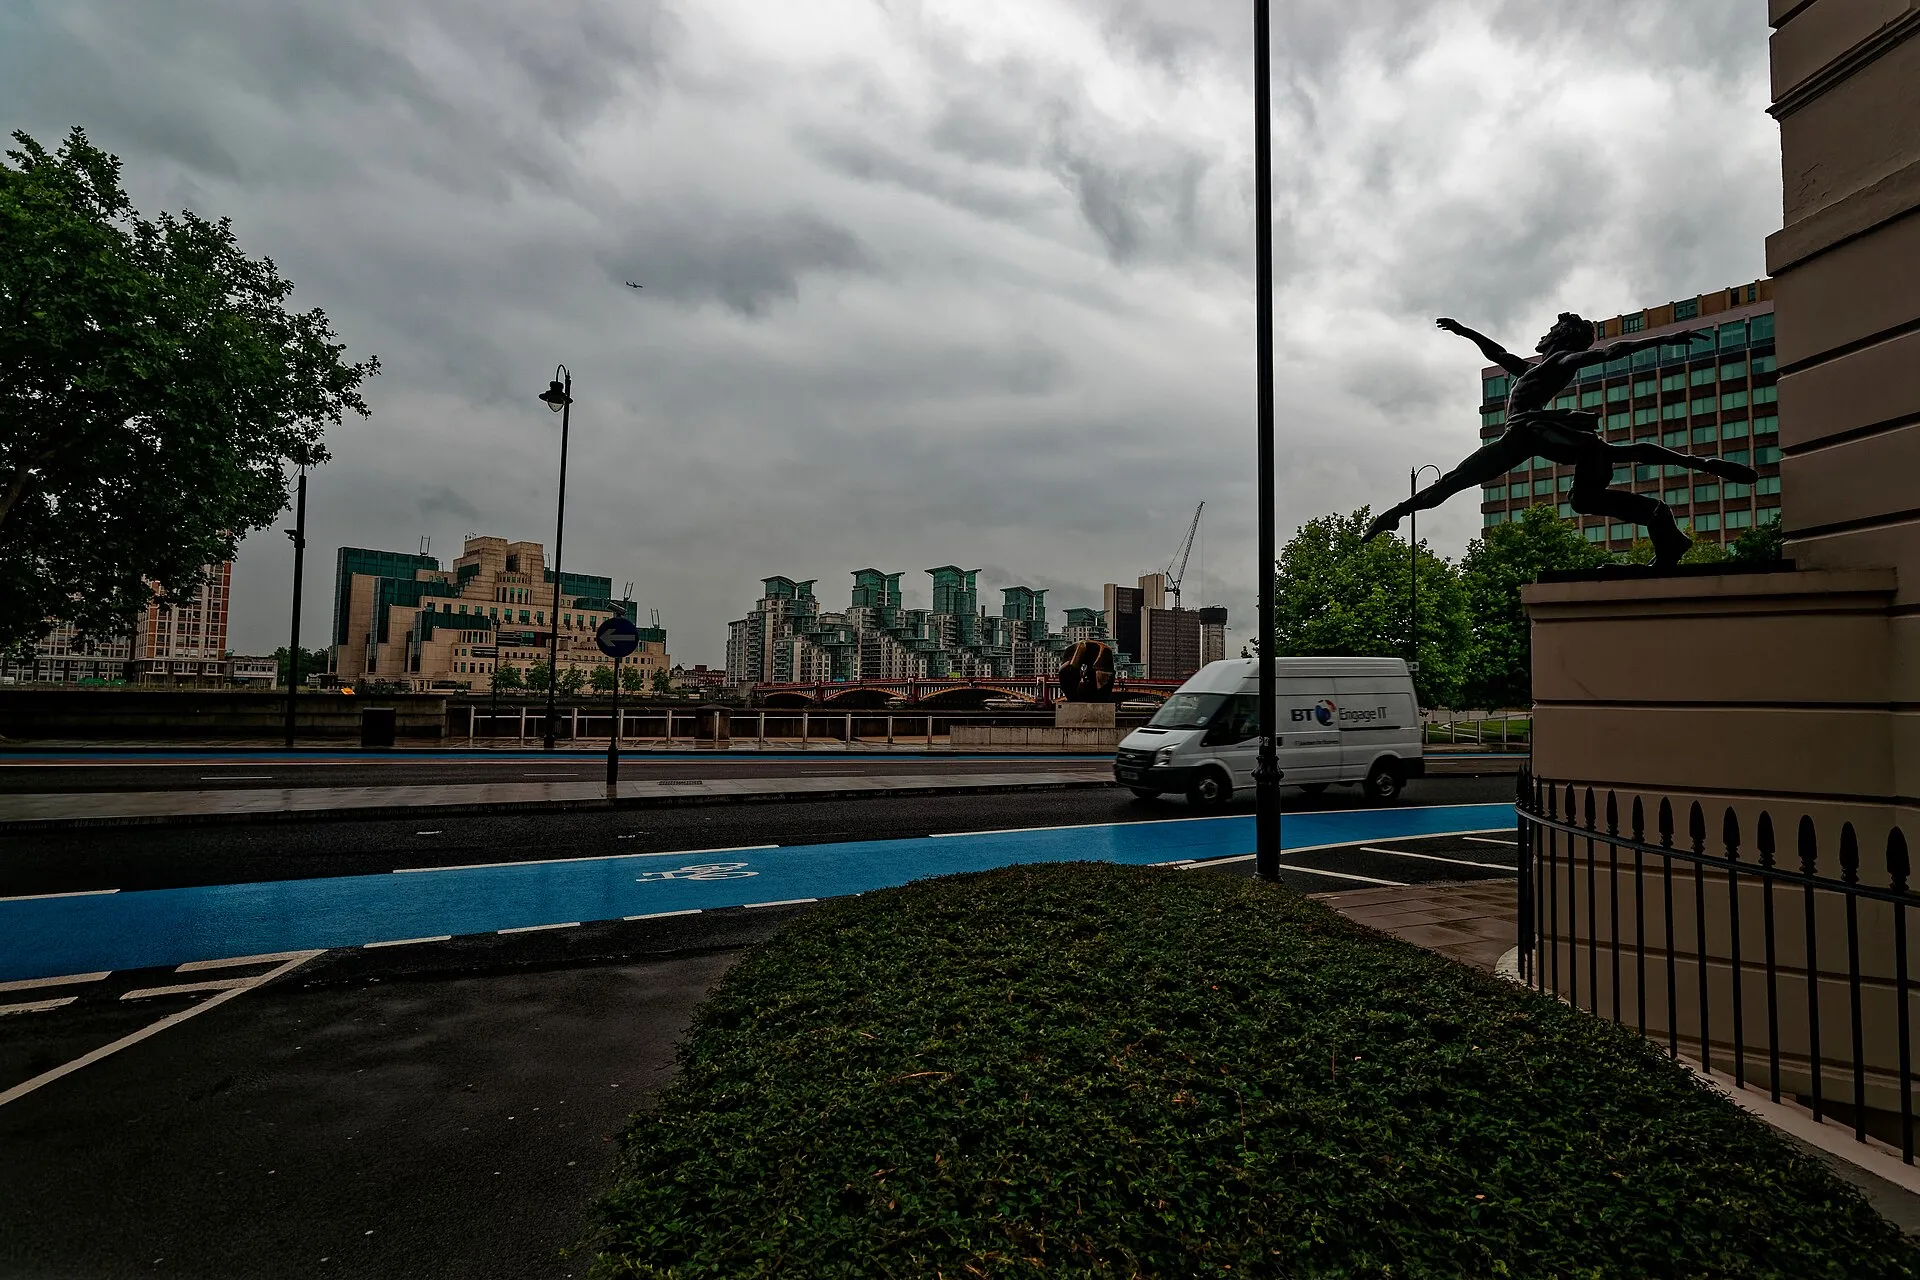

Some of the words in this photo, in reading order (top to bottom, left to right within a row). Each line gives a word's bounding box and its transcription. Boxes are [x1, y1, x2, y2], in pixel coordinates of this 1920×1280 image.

[1290, 708, 1314, 721] BT
[1339, 707, 1376, 723] Engage
[1377, 706, 1387, 719] IT
